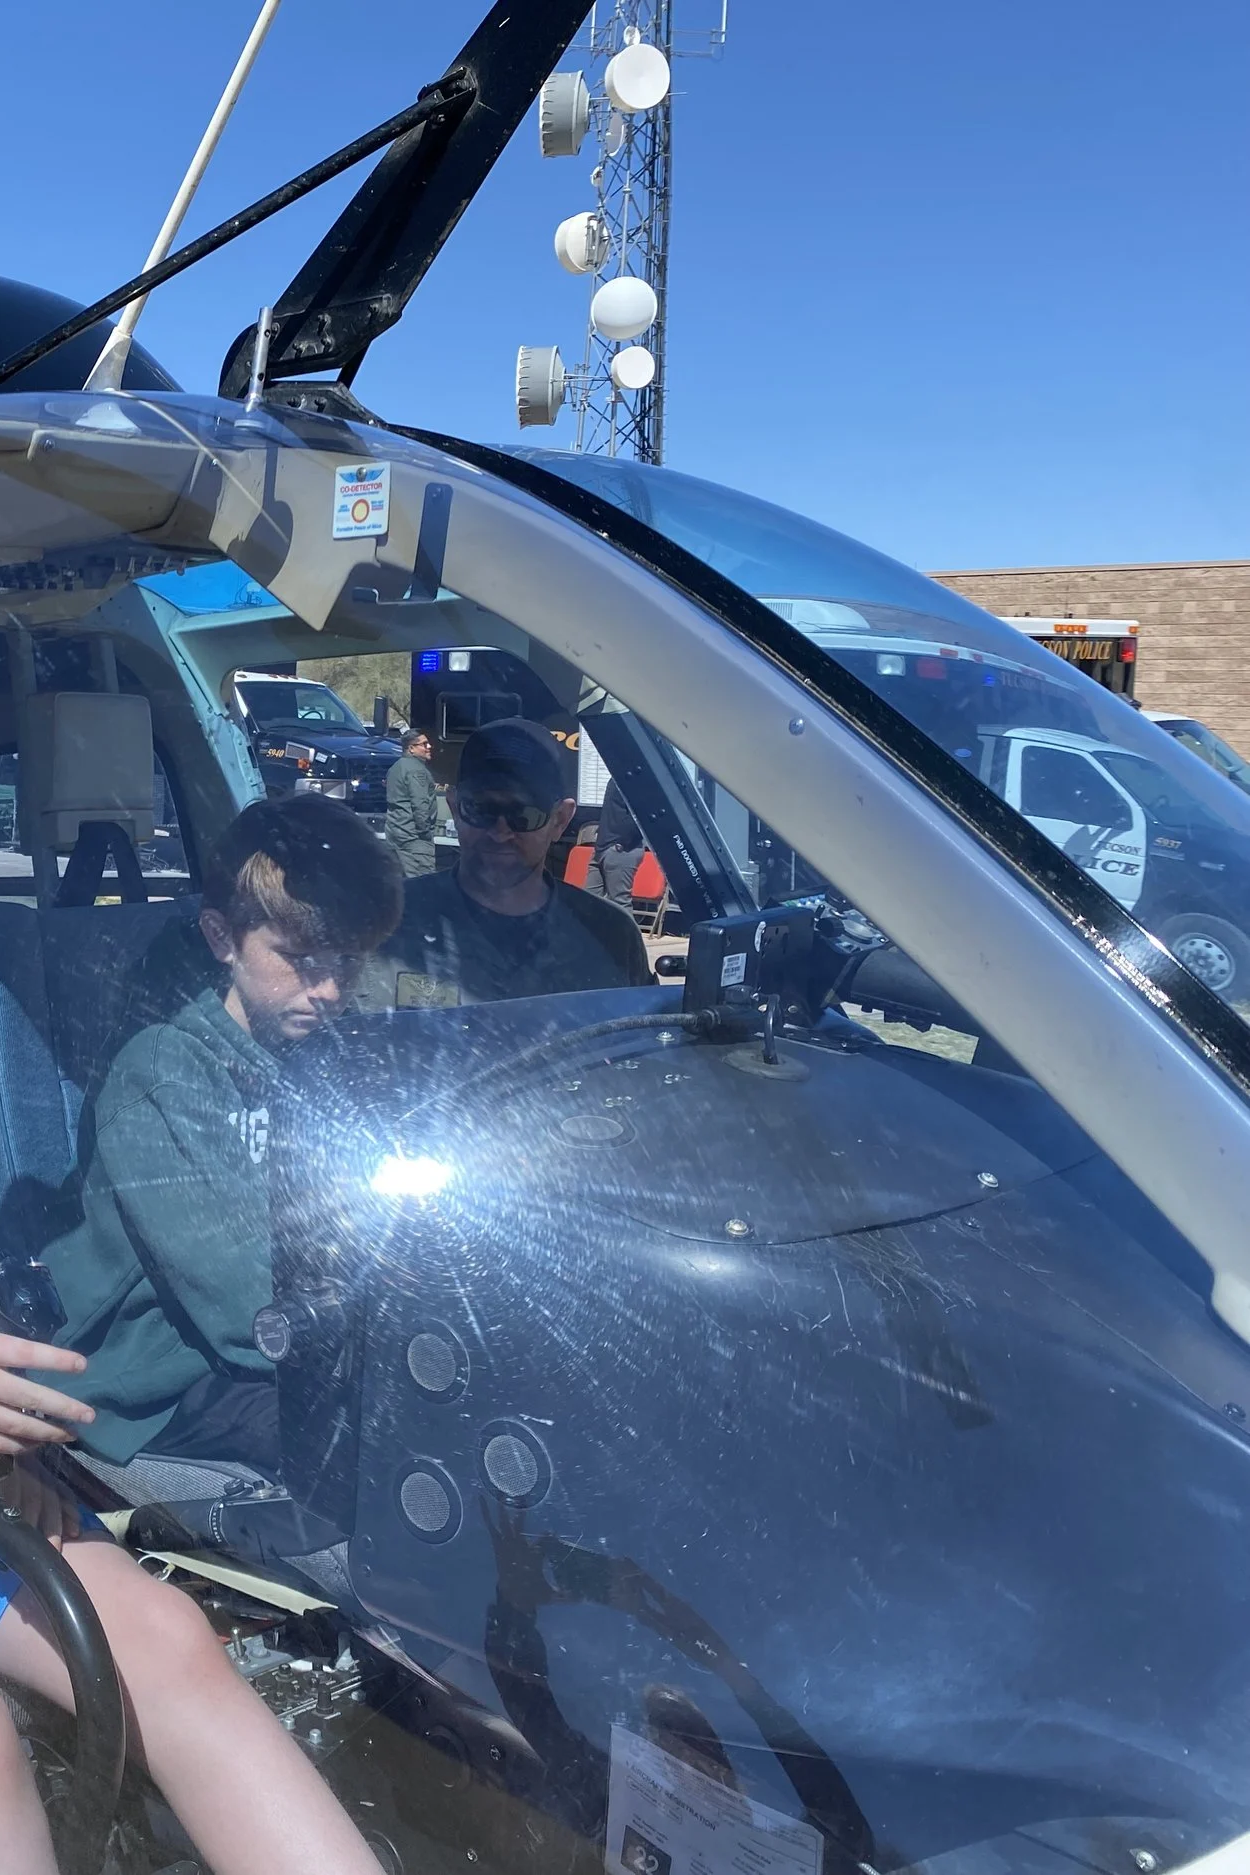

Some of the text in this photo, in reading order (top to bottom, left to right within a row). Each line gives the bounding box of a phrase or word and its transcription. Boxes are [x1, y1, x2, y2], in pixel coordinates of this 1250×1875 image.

[340, 482, 383, 493] CO-DETECTOR
[1039, 640, 1113, 660] CSON POLICE
[266, 748, 284, 758] 5940
[1098, 841, 1142, 854] TUCSON
[1073, 854, 1141, 876] LICE
